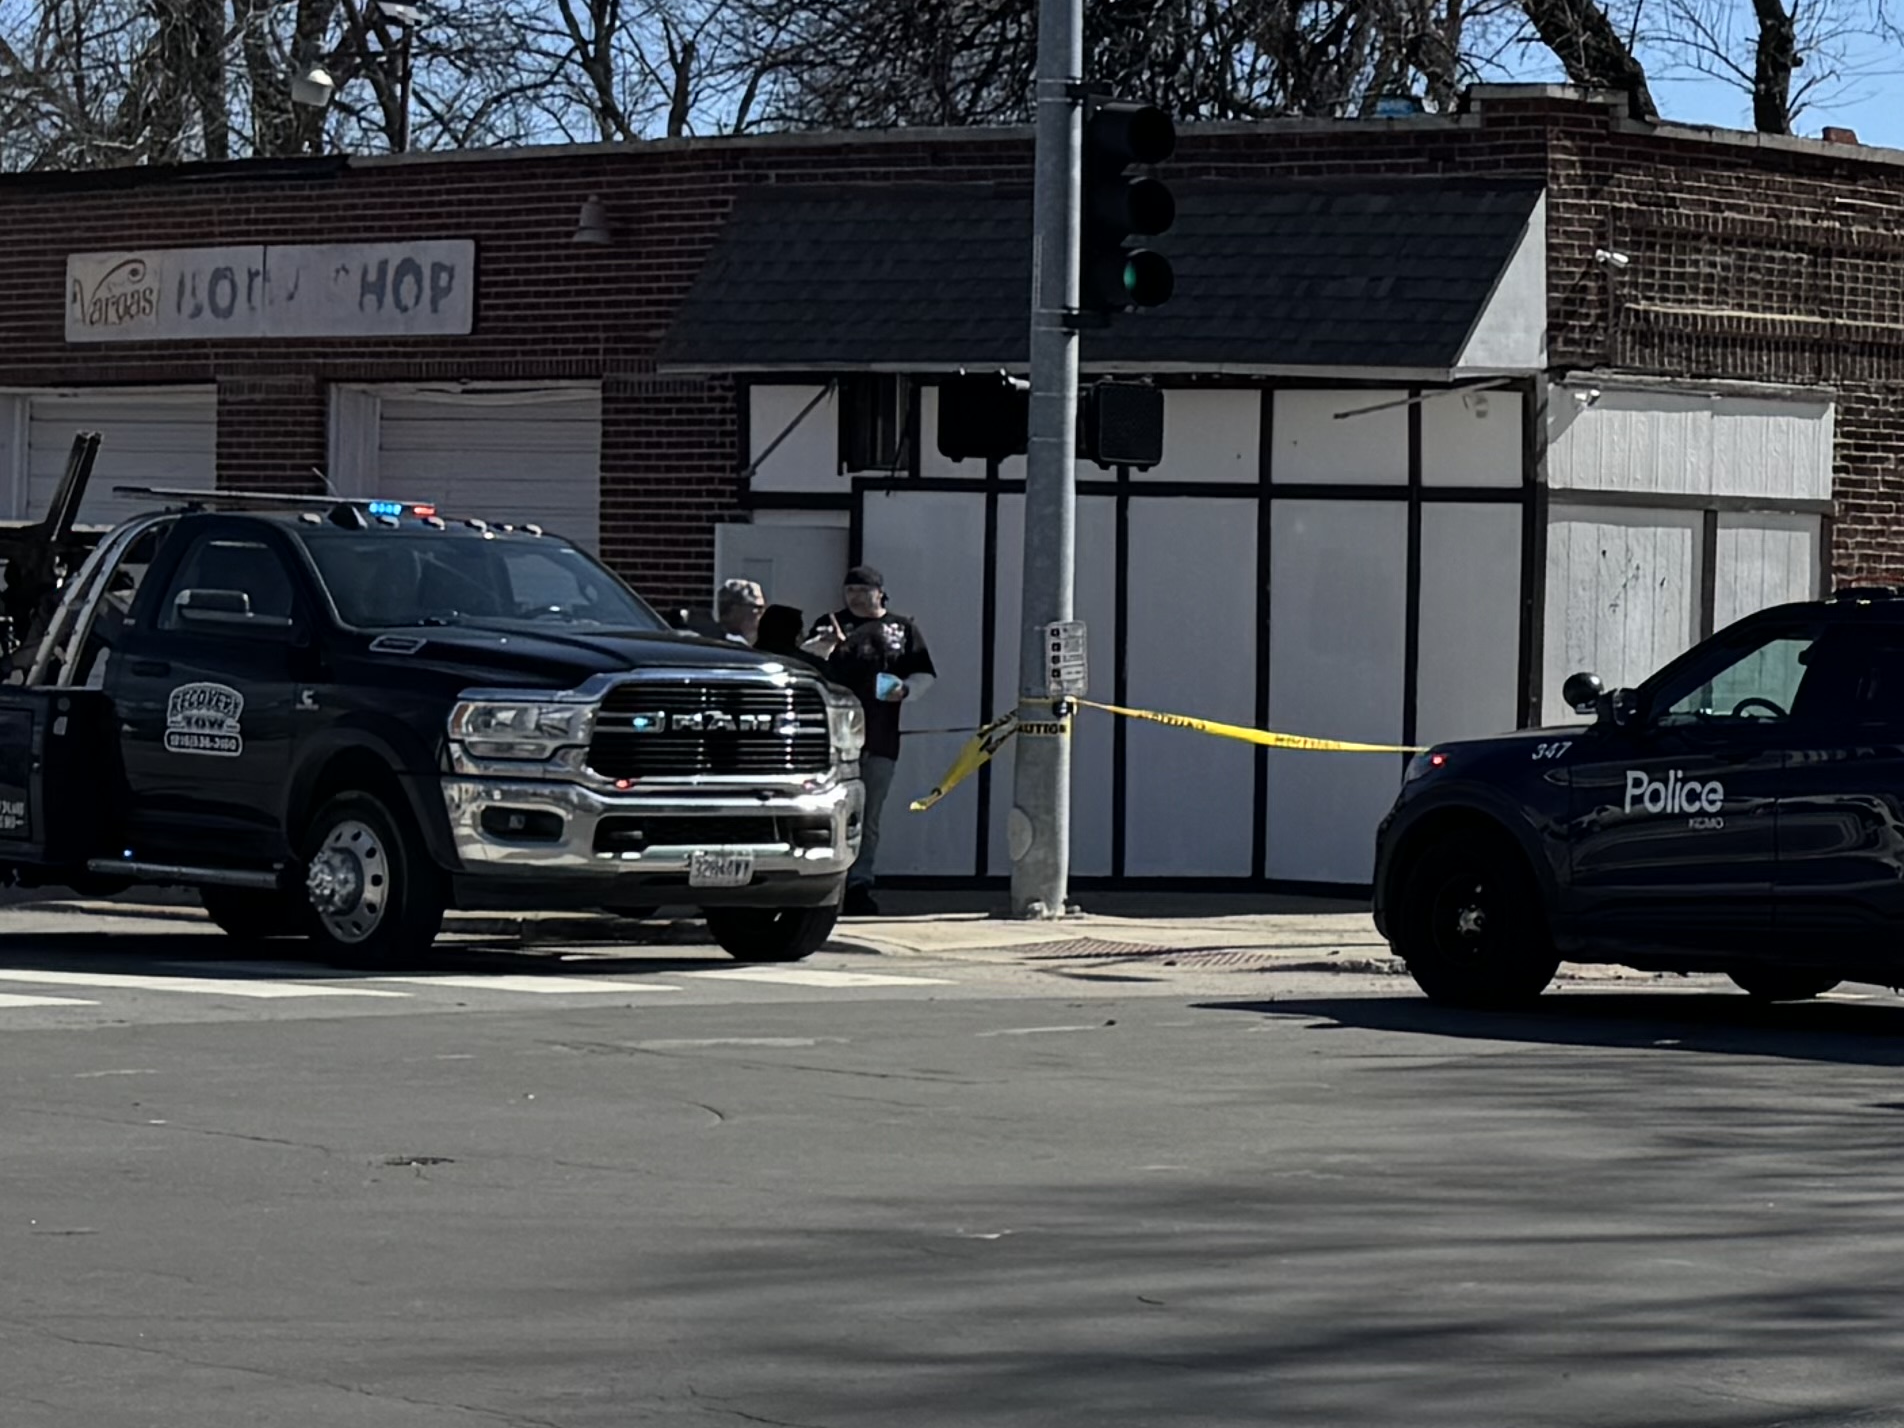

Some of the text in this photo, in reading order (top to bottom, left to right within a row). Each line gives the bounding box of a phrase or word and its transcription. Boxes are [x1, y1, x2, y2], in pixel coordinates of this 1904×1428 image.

[334, 256, 455, 315] HOP
[671, 710, 773, 732] RAM
[1531, 741, 1573, 760] 347
[1624, 769, 1724, 814] Police
